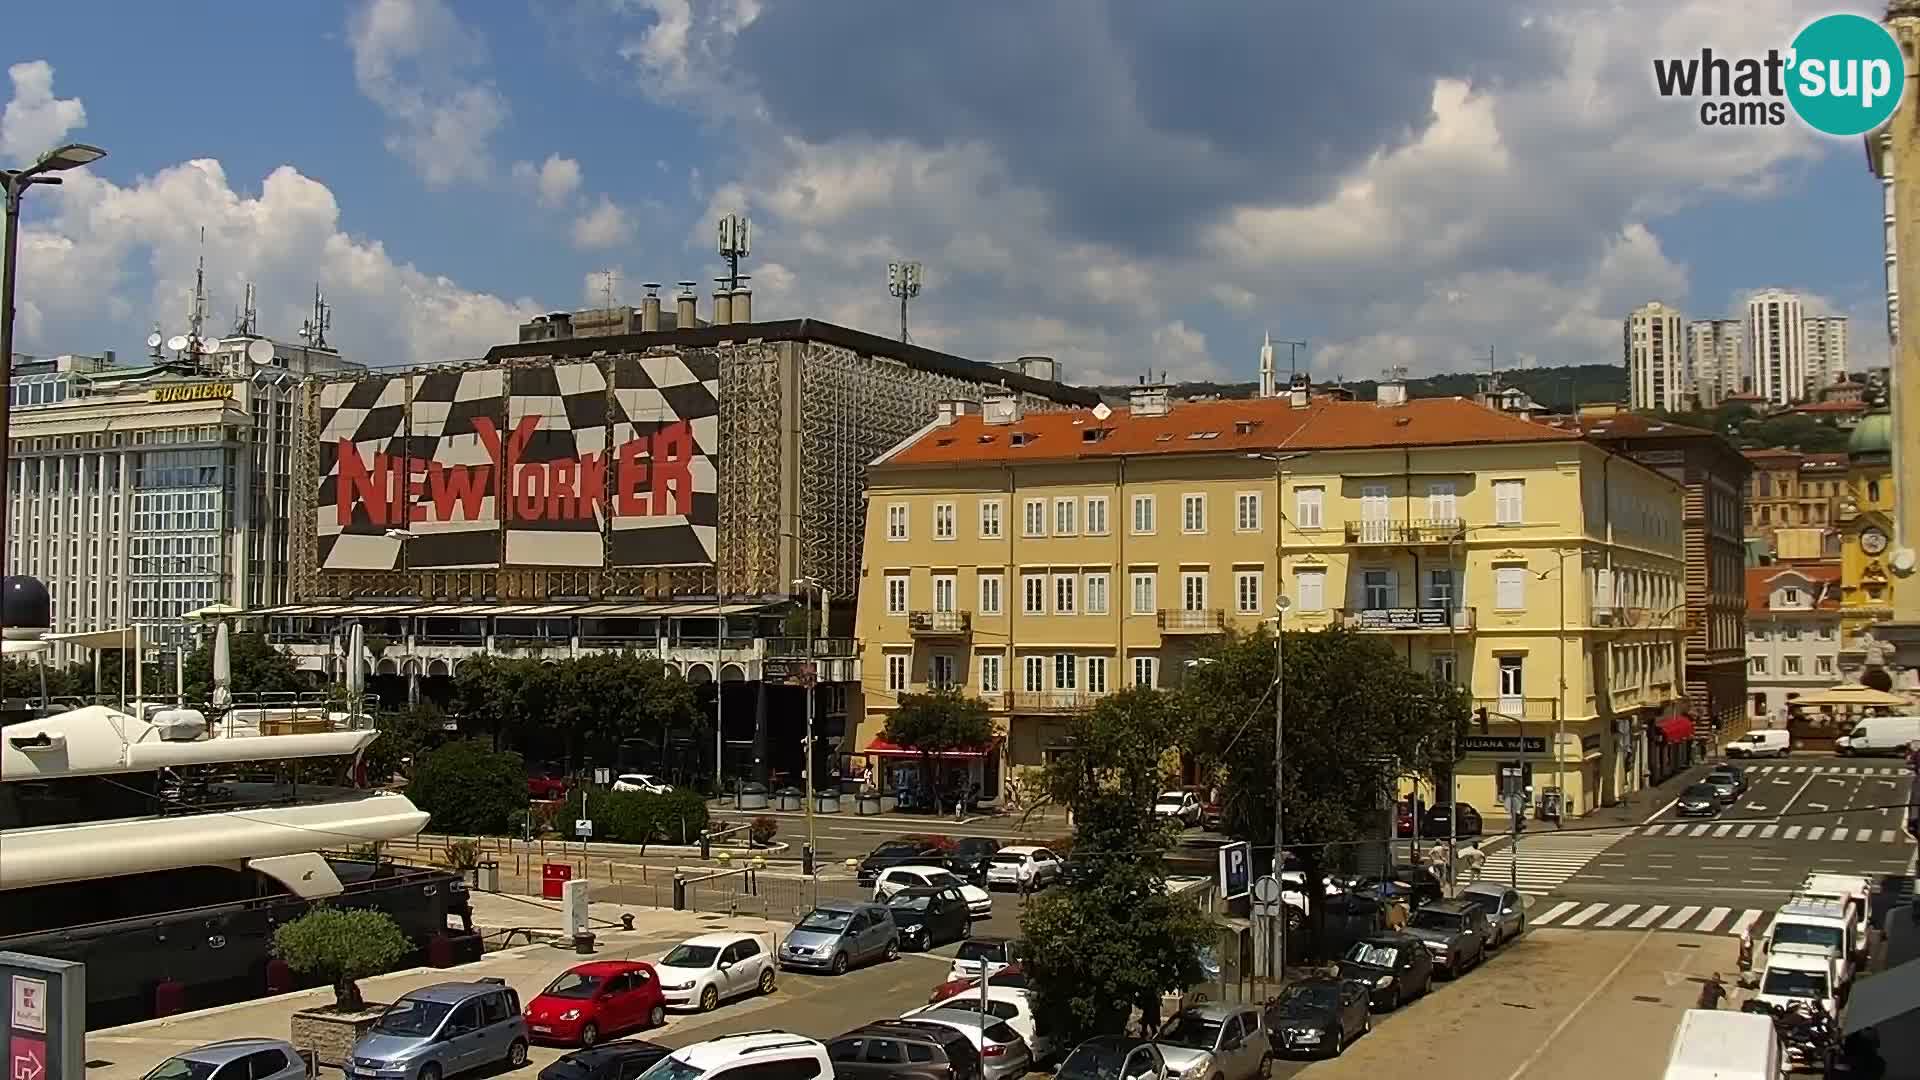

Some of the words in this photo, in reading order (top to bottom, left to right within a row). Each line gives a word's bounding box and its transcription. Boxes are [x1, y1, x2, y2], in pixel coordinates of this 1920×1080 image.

[154, 383, 232, 402] EUROHERC
[337, 436, 490, 526] NEW
[470, 415, 694, 521] YORKER
